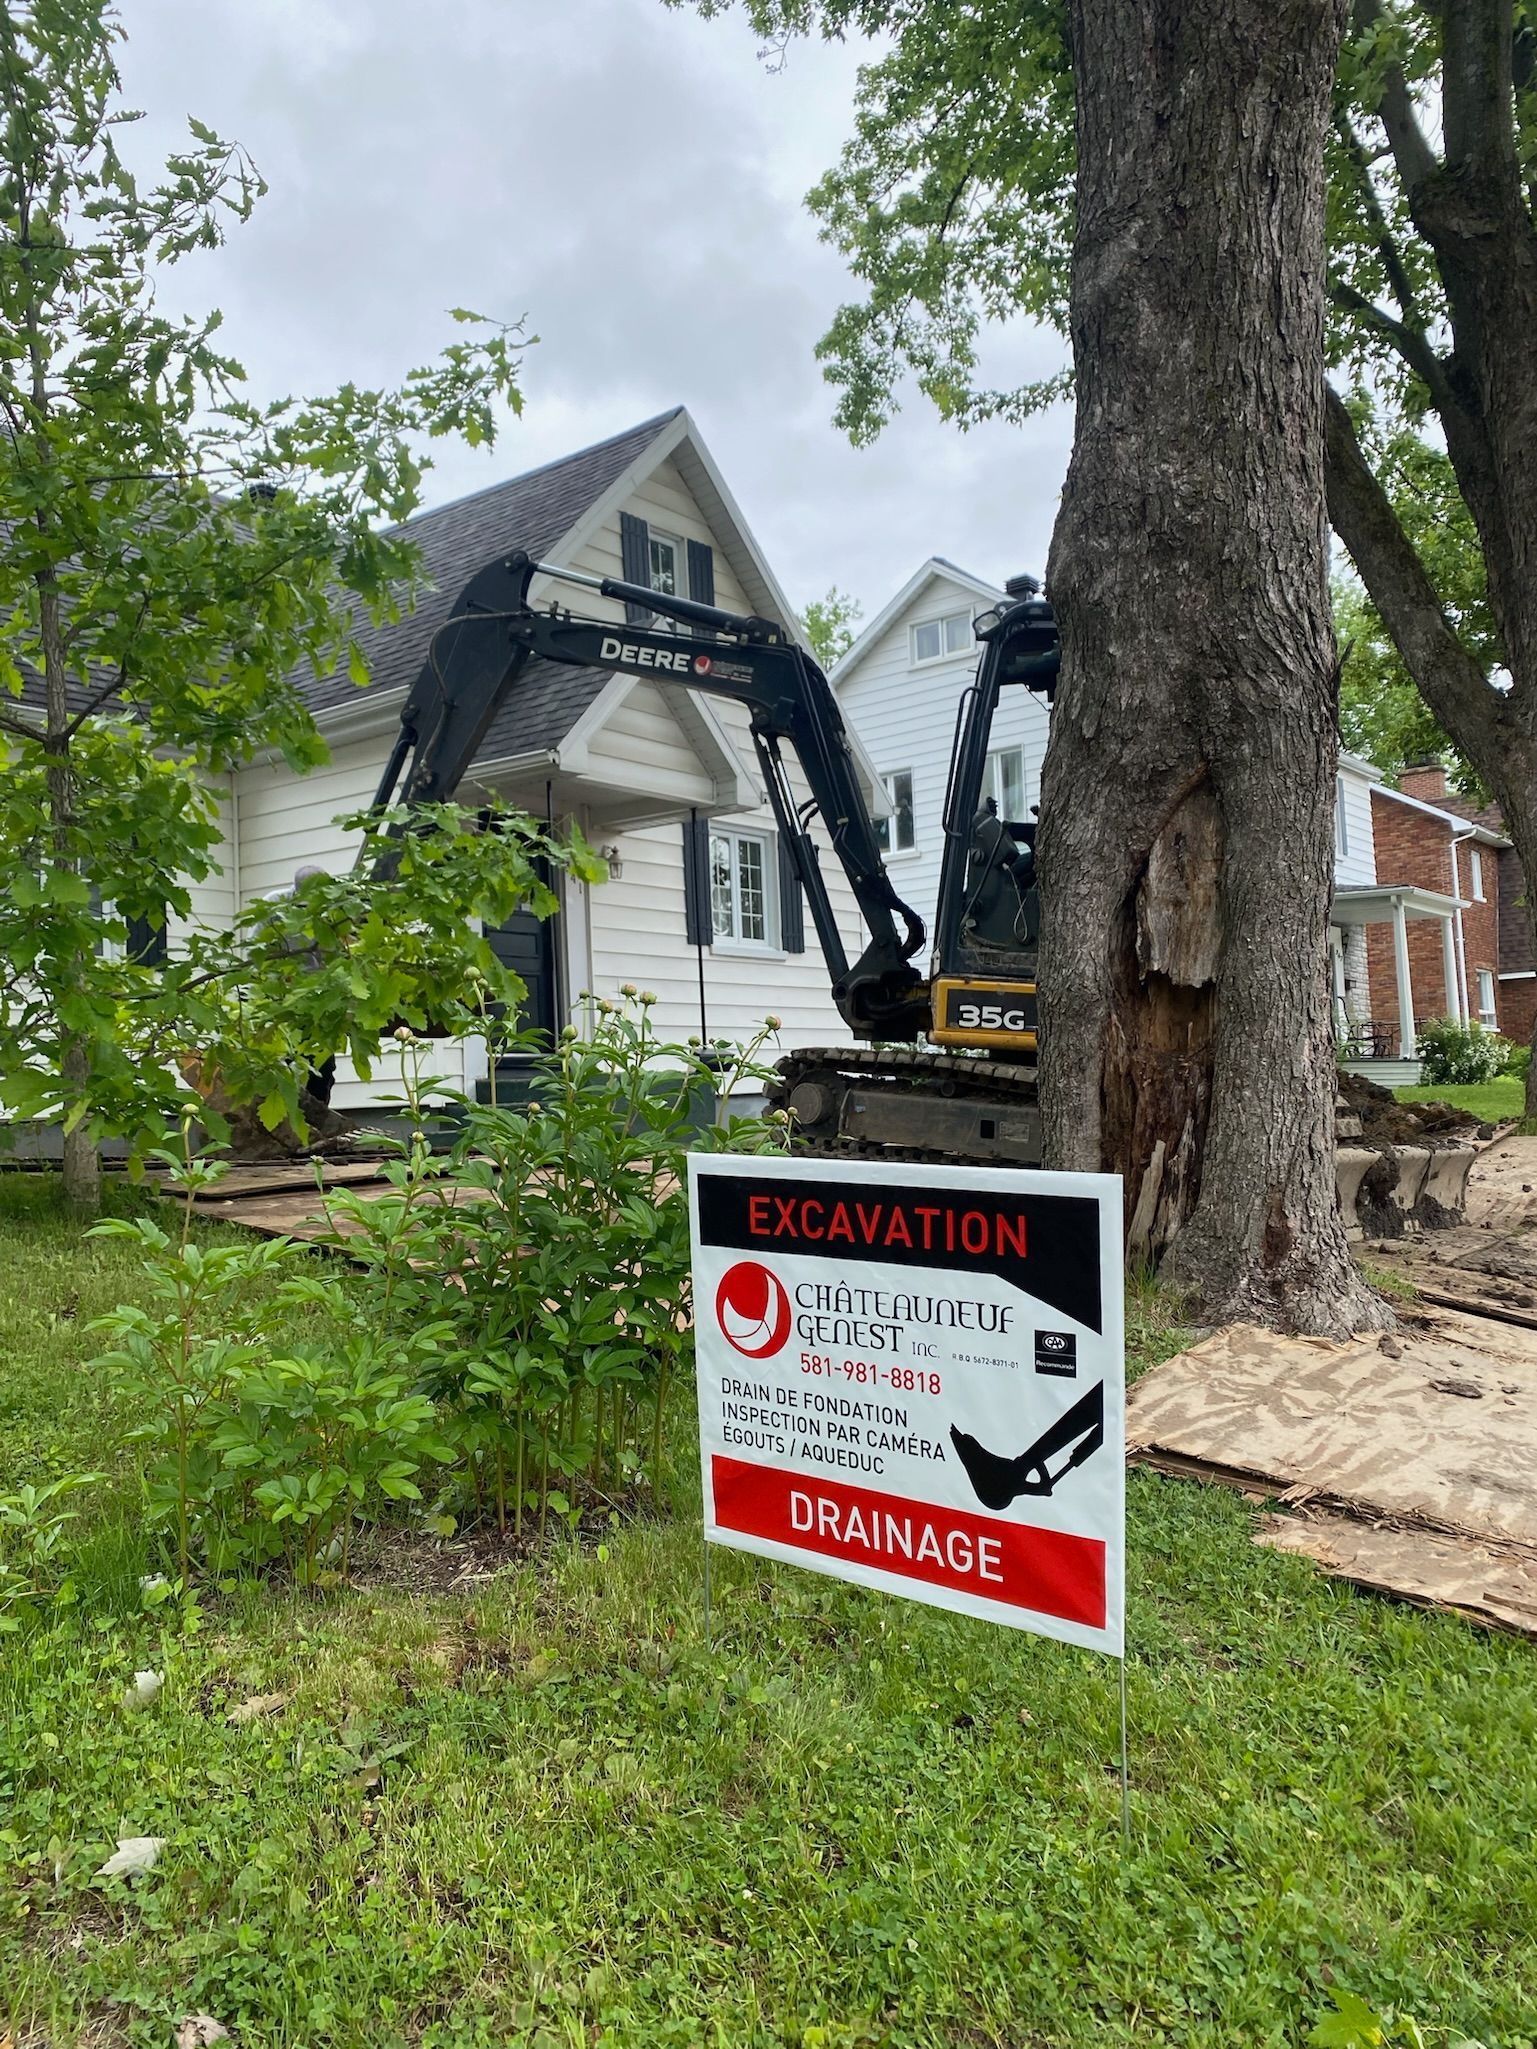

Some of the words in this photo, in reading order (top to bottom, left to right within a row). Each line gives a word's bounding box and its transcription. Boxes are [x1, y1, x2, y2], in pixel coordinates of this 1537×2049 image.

[600, 637, 691, 672] DEERE
[959, 1004, 1024, 1030] 35G
[749, 1196, 1028, 1258] EXCAVATION
[795, 1280, 1014, 1334] CHÂTEAUNEUF
[797, 1314, 904, 1352] GENEST
[1047, 1336, 1064, 1350] CAA
[800, 1352, 942, 1395] 581-981-8818
[973, 1356, 1020, 1369] 5672-8371-01
[721, 1377, 770, 1402] DRAIN
[776, 1388, 797, 1407] DE
[804, 1393, 907, 1427] FONDATION
[722, 1401, 820, 1436] INSPECTION
[827, 1421, 860, 1444] PAR
[866, 1432, 945, 1462] CAMÉRA
[723, 1421, 785, 1453] ÉGOUTS
[801, 1442, 884, 1474] AQUEDUC
[790, 1490, 1004, 1583] DRAINAGE
